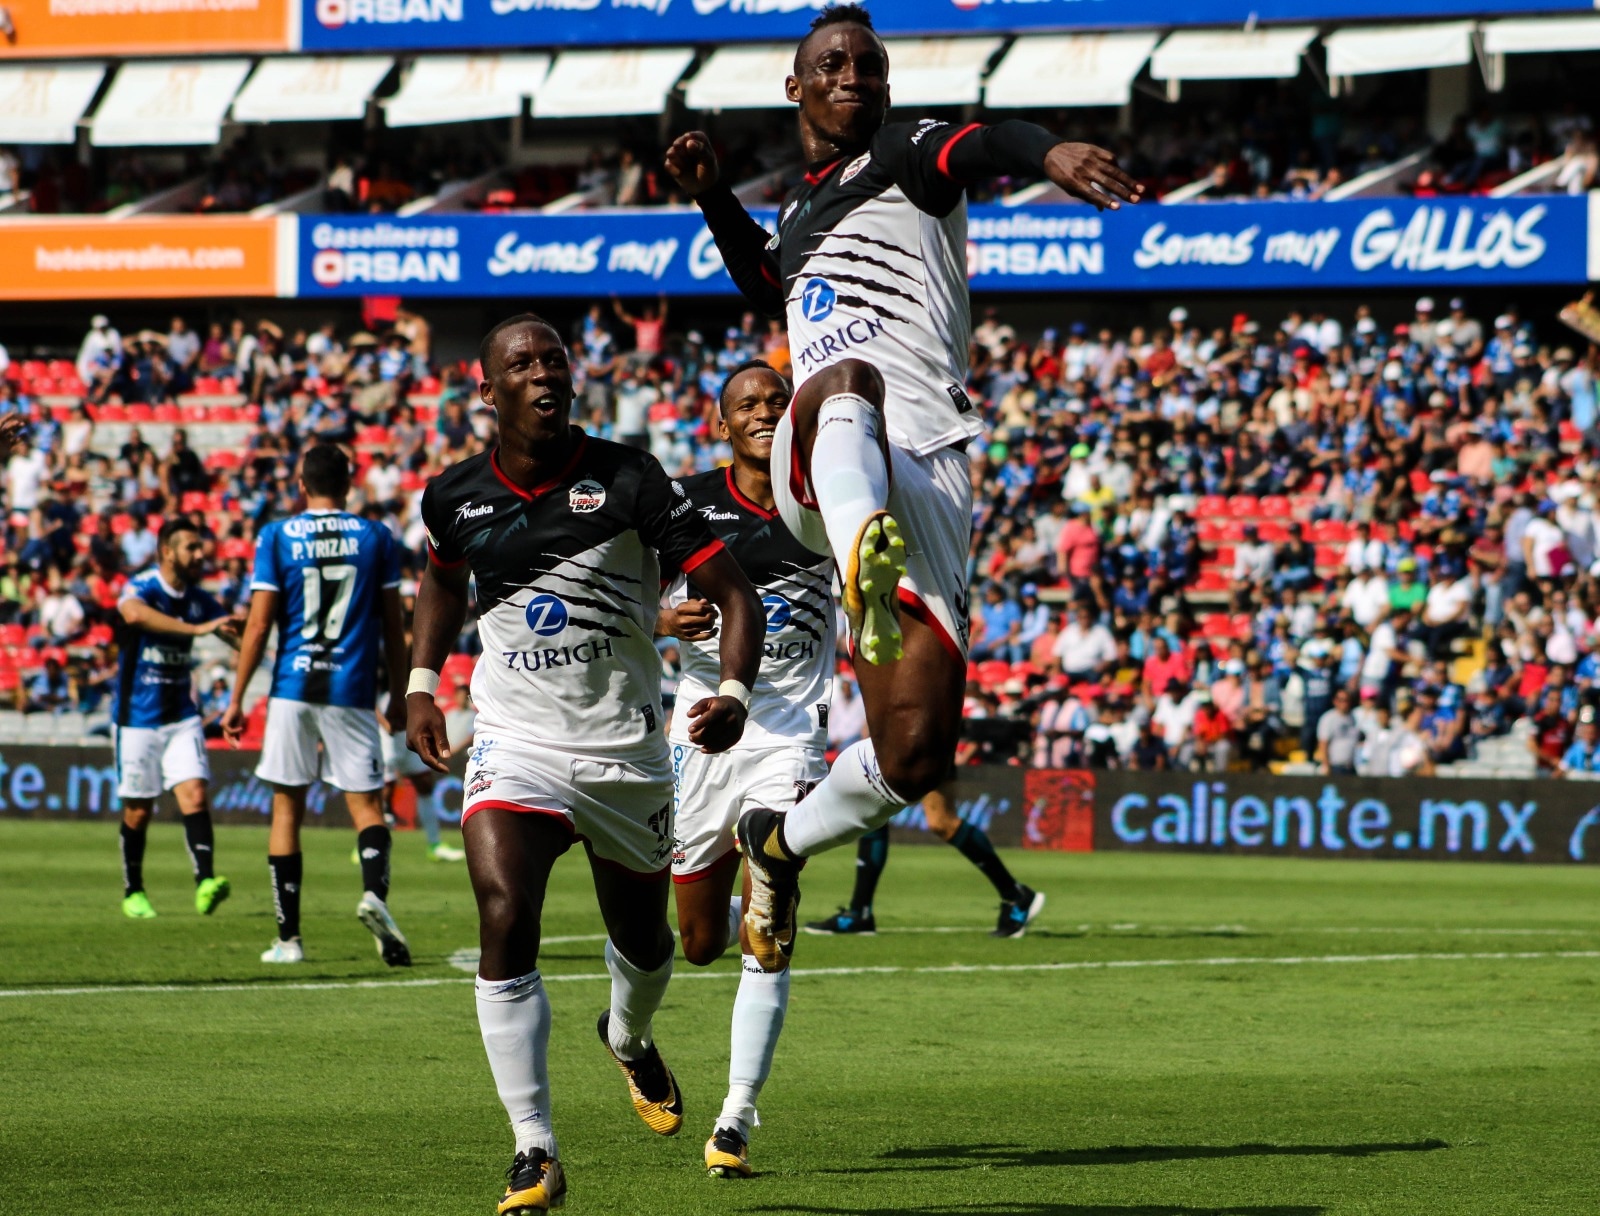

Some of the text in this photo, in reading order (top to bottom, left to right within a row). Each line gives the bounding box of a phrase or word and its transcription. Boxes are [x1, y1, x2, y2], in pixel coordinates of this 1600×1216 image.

[312, 222, 458, 249] Gasolineras
[967, 213, 1103, 239] asolineras
[1133, 203, 1547, 272] Somos muy GALLOS
[312, 249, 460, 287] ORSAN
[487, 231, 604, 276] Somos
[607, 237, 678, 280] muy
[798, 317, 883, 372] ZURICH
[283, 516, 365, 539] Corona
[463, 504, 494, 519] Keuka
[708, 511, 740, 521] Keuka
[301, 564, 358, 640] 17
[502, 637, 615, 673] ZURICH
[763, 640, 814, 660] RICH
[1111, 780, 1539, 853] caliente.mx
